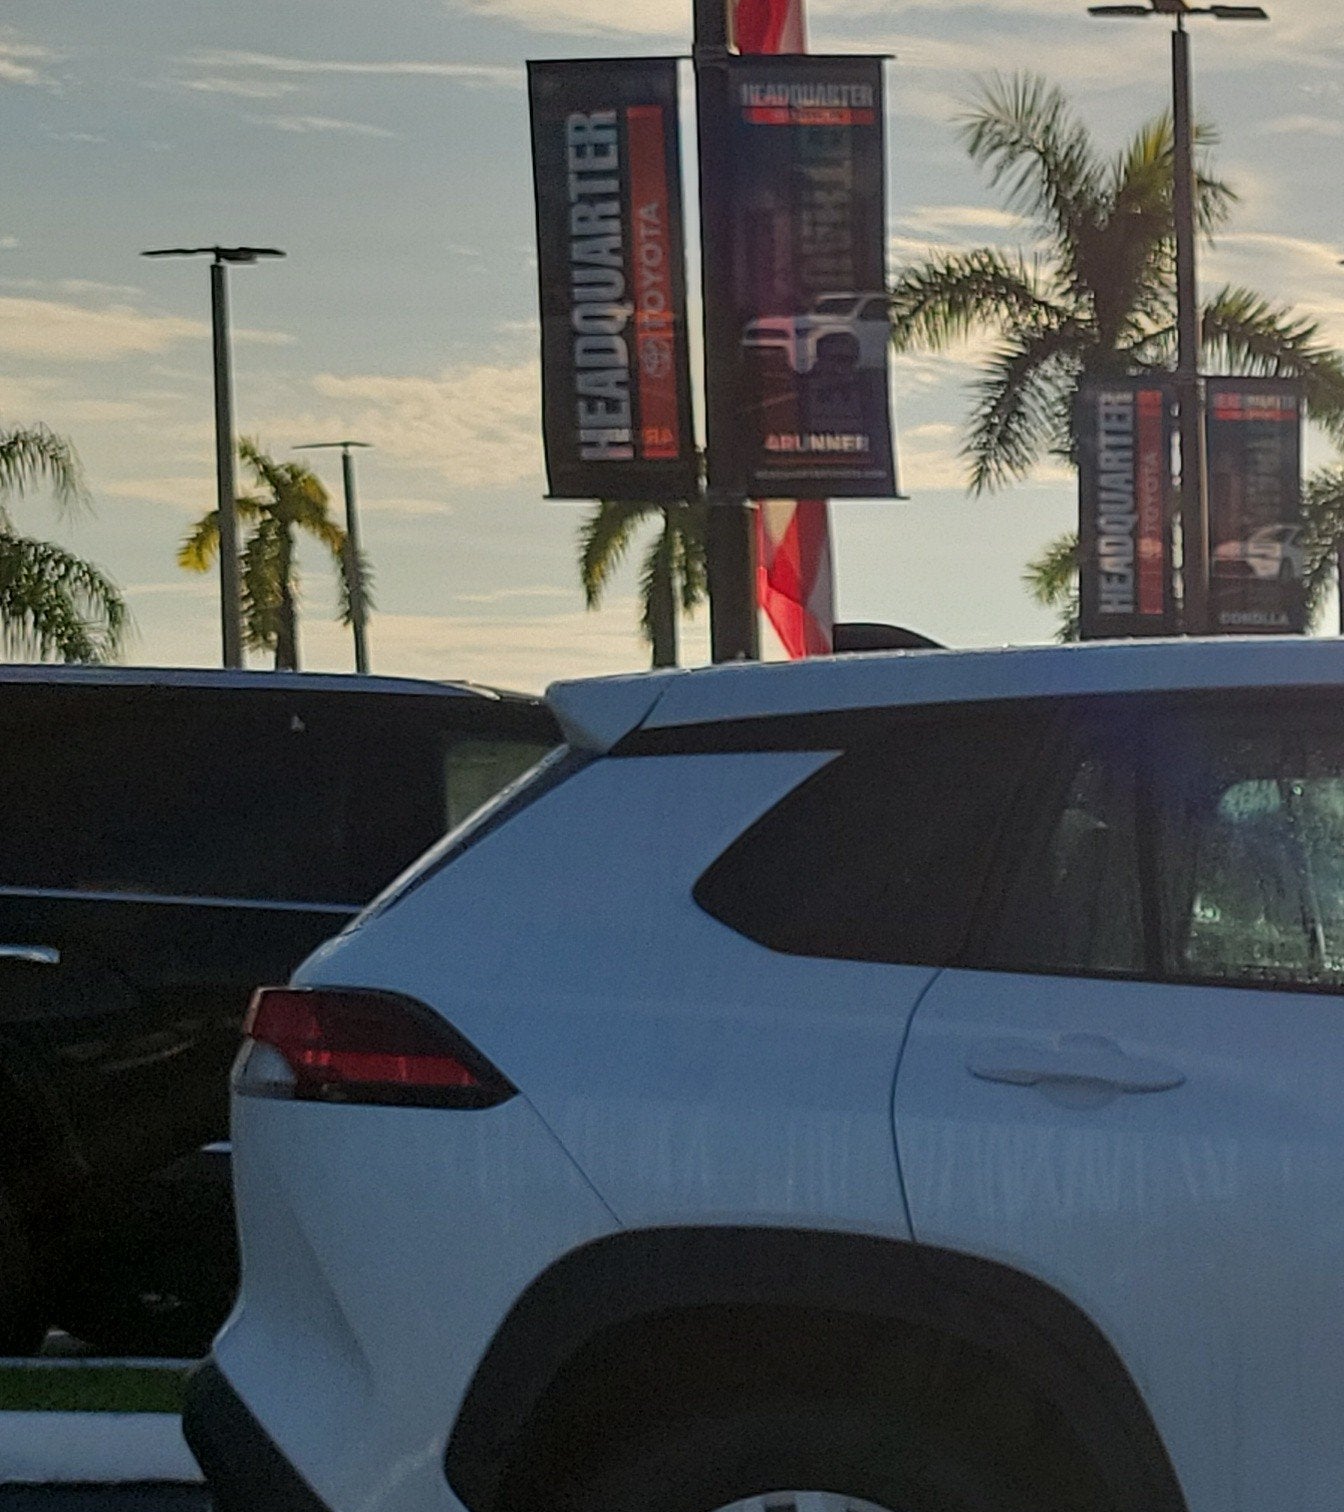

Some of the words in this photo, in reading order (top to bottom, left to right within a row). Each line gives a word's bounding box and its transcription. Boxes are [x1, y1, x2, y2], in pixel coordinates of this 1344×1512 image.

[567, 110, 635, 461] HEADQUARTER
[639, 203, 666, 329] TOYOTA
[1098, 391, 1138, 614] HEADQUARTER
